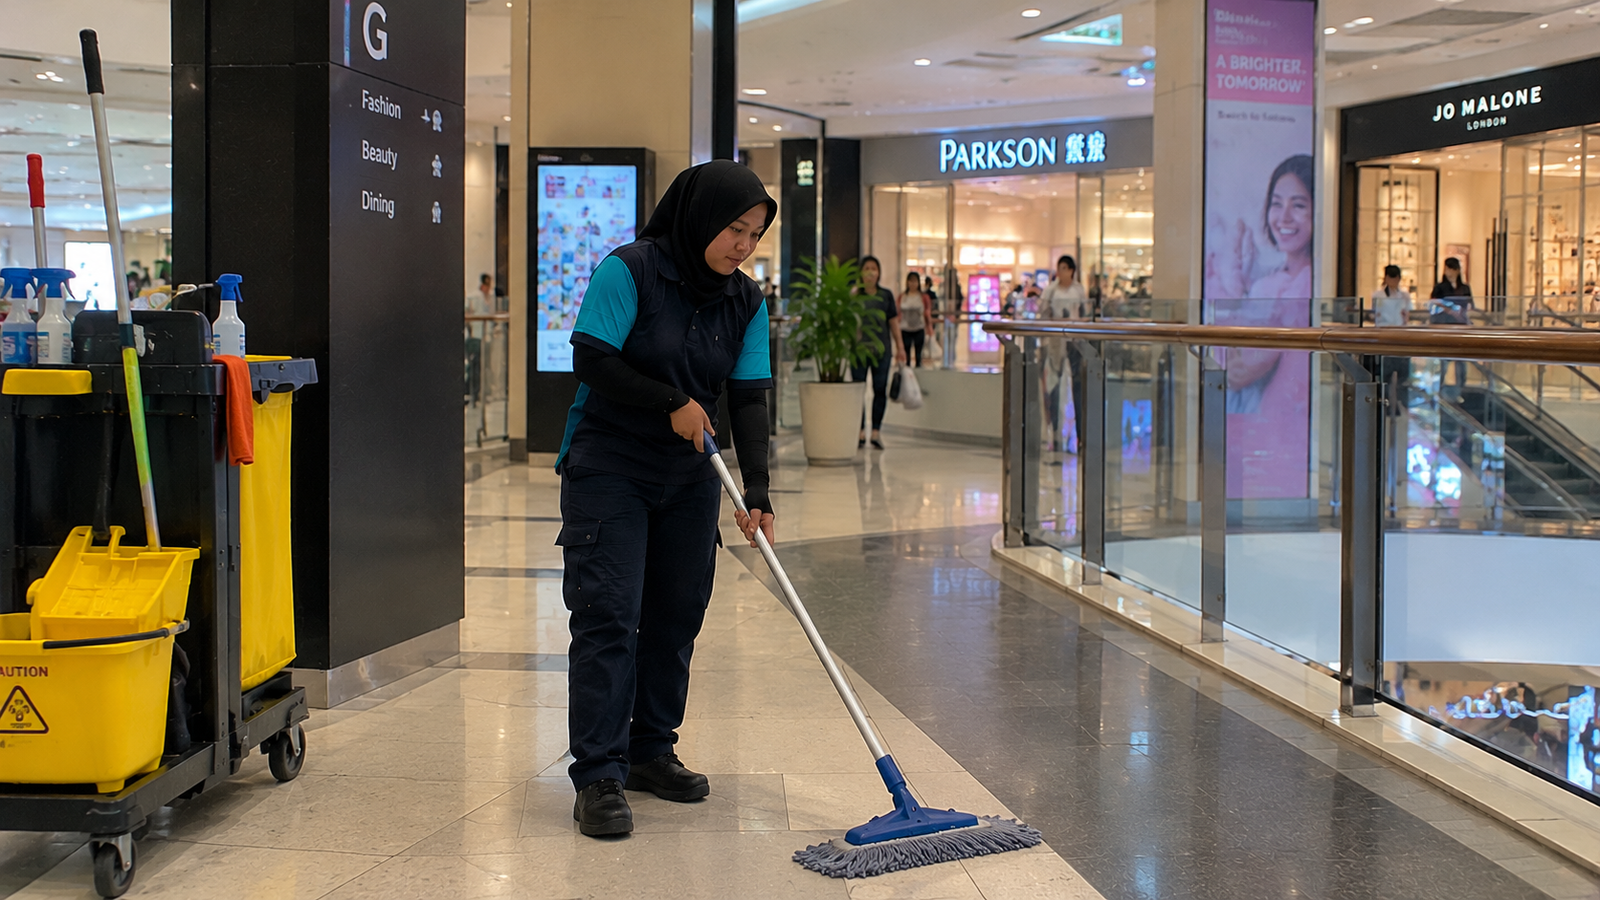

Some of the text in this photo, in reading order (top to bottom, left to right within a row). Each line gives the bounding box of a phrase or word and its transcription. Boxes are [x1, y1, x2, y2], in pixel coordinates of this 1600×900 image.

[362, 1, 388, 61] G
[1215, 53, 1227, 69] A
[362, 88, 402, 120] Fashion
[1432, 85, 1542, 122] JO MALONE
[362, 139, 398, 171] Beauty
[940, 136, 1056, 173] PARKSON
[362, 190, 395, 219] Dining
